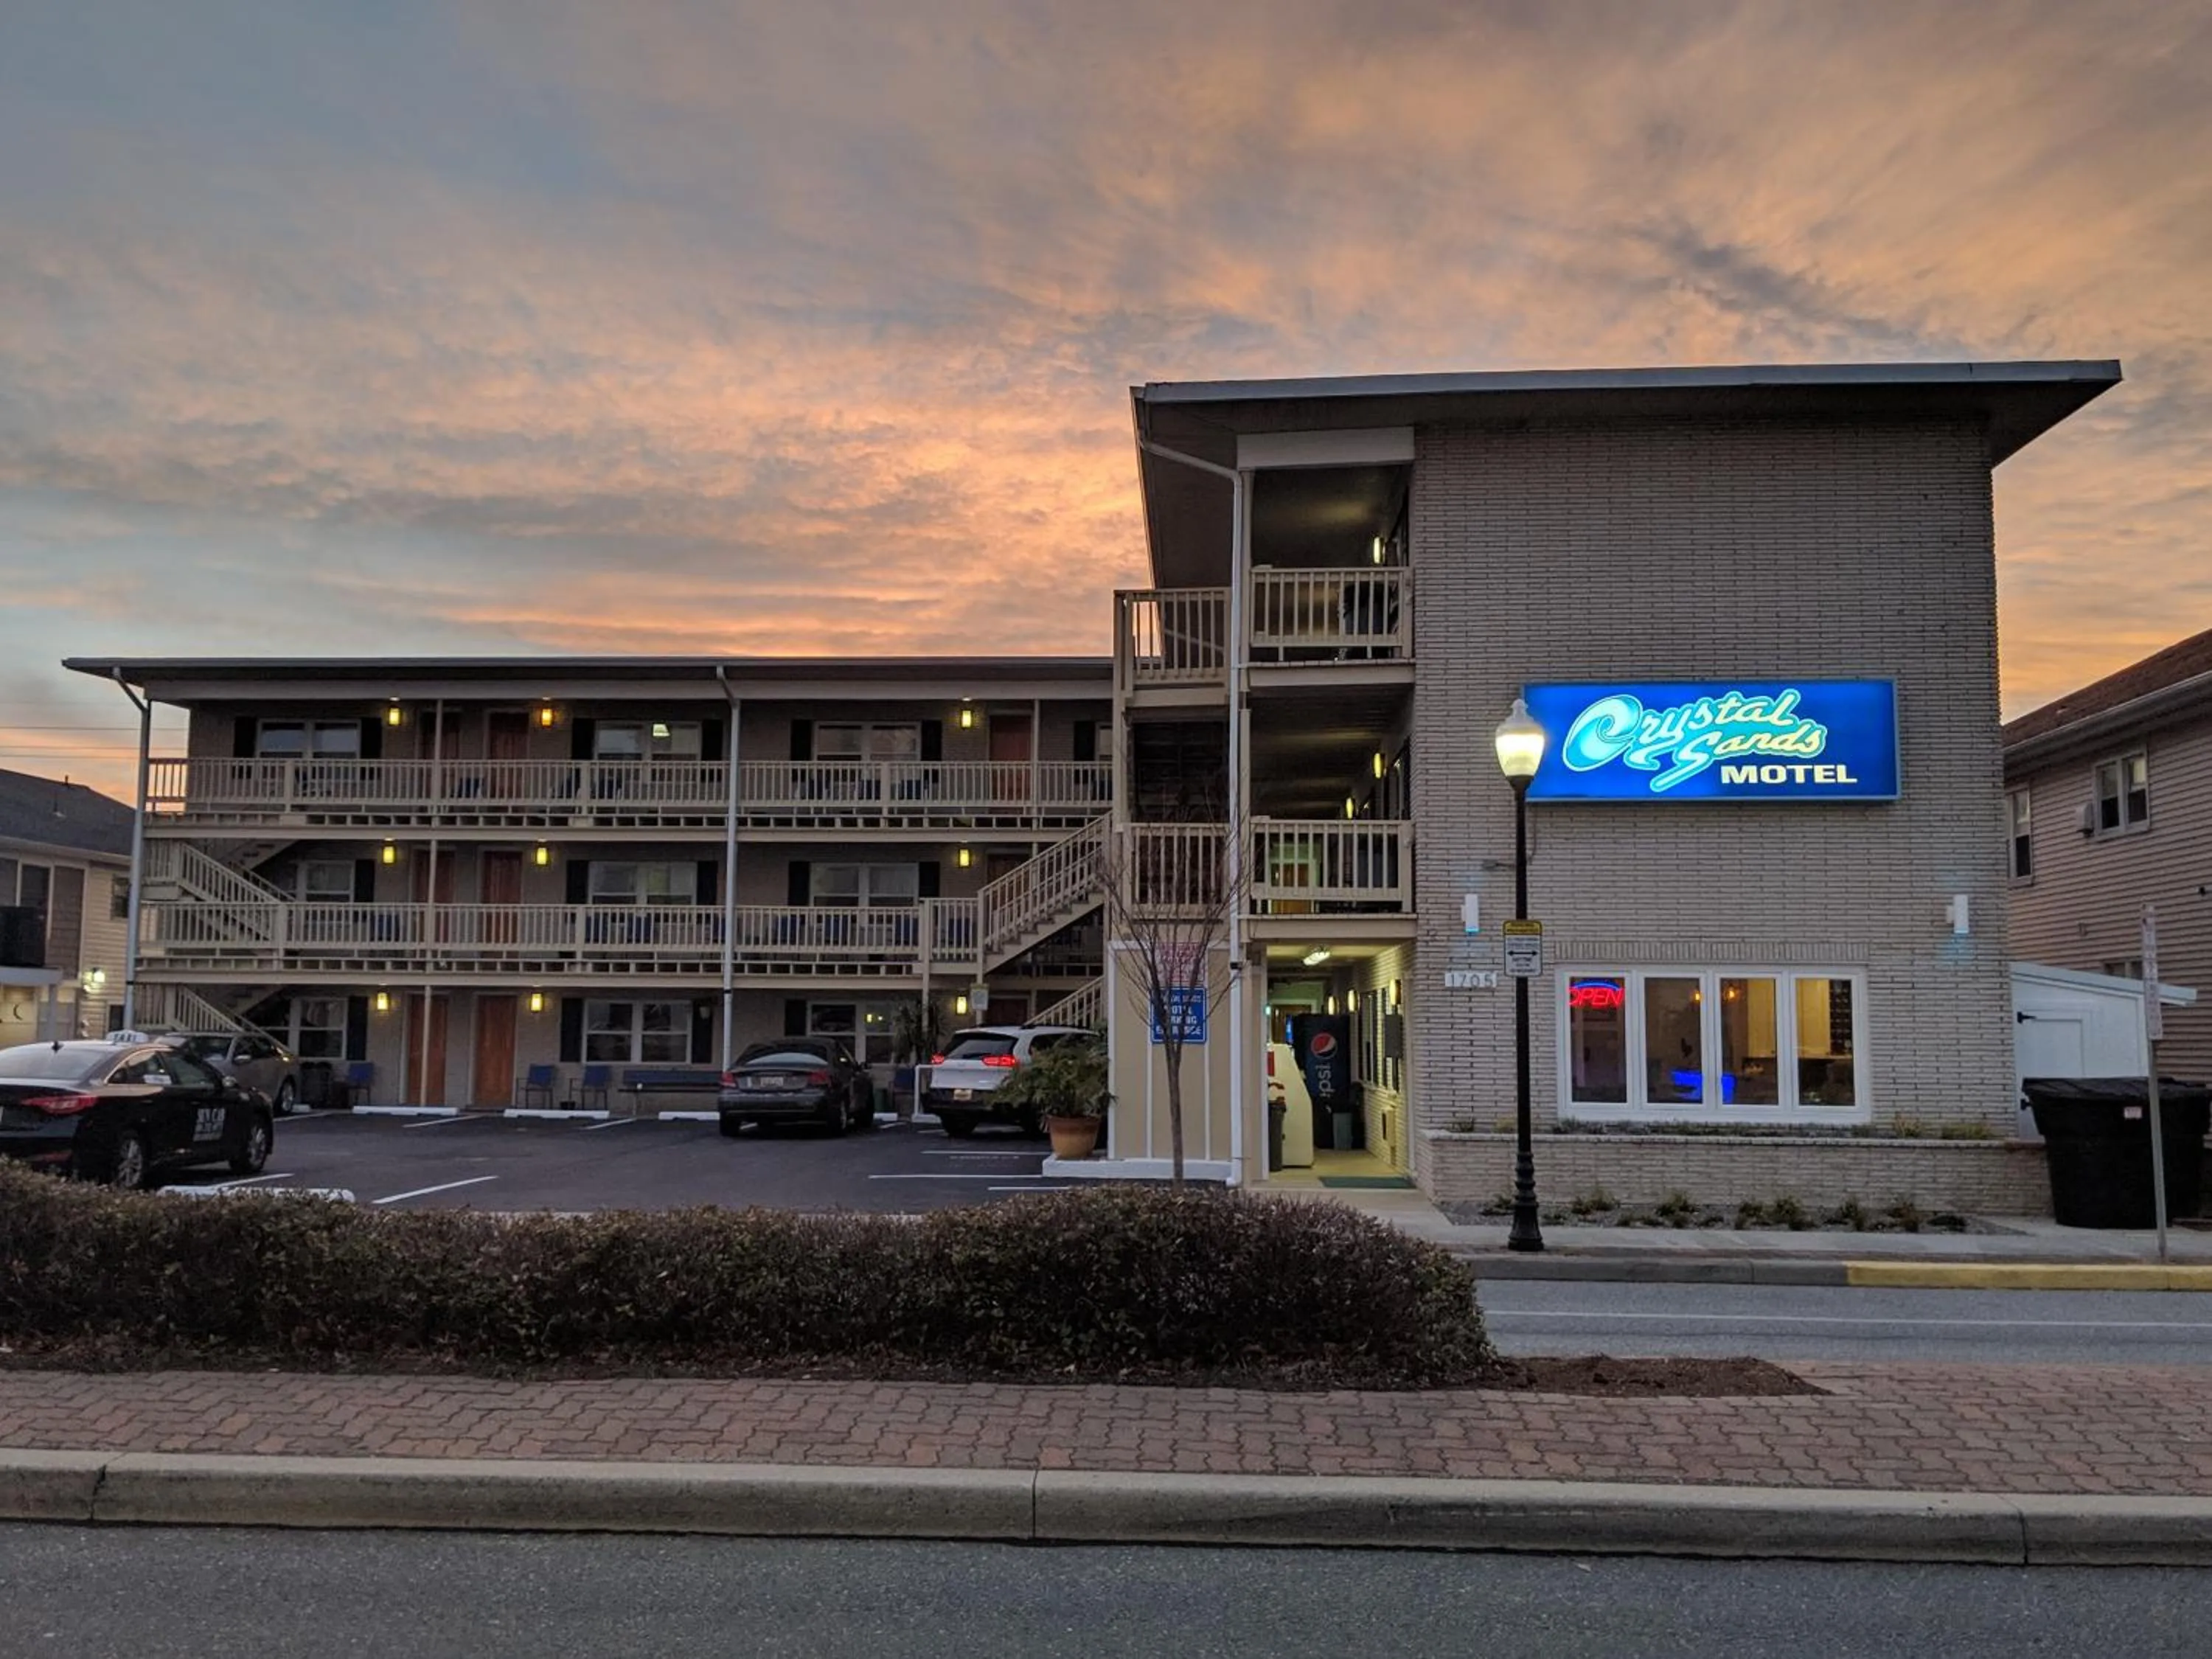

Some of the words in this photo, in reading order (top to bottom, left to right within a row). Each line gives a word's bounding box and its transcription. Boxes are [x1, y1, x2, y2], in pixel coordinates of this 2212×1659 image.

[1563, 689, 1800, 771] Crystal
[1650, 719, 1826, 792] Sands
[1721, 765, 1857, 784] MOTEL
[1450, 973, 1494, 987] 1705
[1568, 987, 1625, 1007] OPEN
